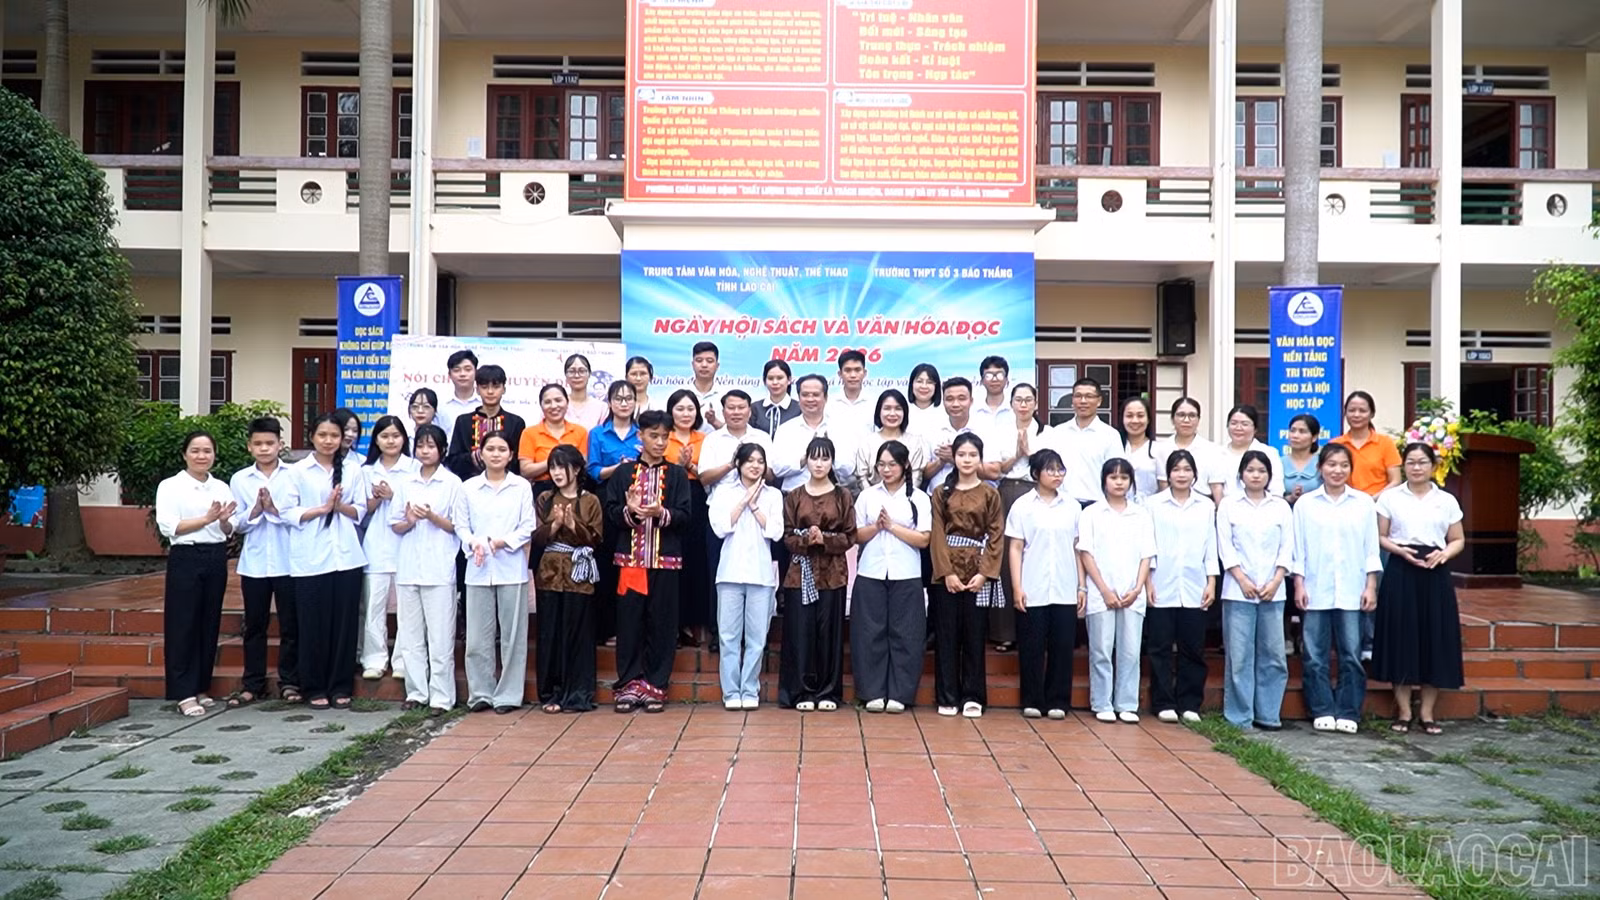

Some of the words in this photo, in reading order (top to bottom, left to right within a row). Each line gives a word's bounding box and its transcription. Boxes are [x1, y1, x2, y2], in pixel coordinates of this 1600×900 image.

[878, 12, 896, 24] tuệ
[908, 12, 938, 22] Nhân
[942, 13, 963, 23] văn
[859, 24, 878, 37] Đổi
[882, 26, 904, 37] mới
[916, 26, 946, 38] Sáng
[949, 28, 967, 38] tạo
[860, 41, 892, 52] Trung
[896, 41, 921, 53] thực
[932, 41, 966, 52] Trách
[968, 42, 1005, 54] nhiệm
[859, 54, 888, 65] Đoàn
[892, 54, 911, 65] kết
[938, 55, 960, 66] luật
[859, 69, 880, 79] Tôn
[883, 69, 914, 80] trọng
[926, 70, 948, 80] Hợp
[643, 266, 673, 277] TRUNG
[676, 266, 695, 276] TÂM
[698, 266, 716, 276] VĂN
[719, 266, 740, 278] HÓA,
[805, 264, 822, 277] THỂ
[825, 267, 848, 277] THAO
[874, 267, 910, 278] TRƯỜNG
[913, 268, 936, 278] THPT
[938, 266, 950, 278] SỐ
[953, 268, 959, 278] 3
[962, 266, 980, 278] BẢO
[983, 266, 1012, 278] THẮNG
[716, 280, 737, 292] TỈNH
[760, 282, 776, 292] CAI
[654, 314, 716, 334] NGÀY
[719, 315, 758, 338] HỘI
[763, 315, 817, 334] SÁCH
[824, 316, 849, 334] VÀ
[856, 316, 898, 334] VĂN
[905, 316, 949, 335] HÓA
[956, 320, 1000, 340] ĐỌC
[1276, 336, 1295, 347] VĂN
[1296, 336, 1314, 347] HÓA
[1317, 337, 1335, 348] ĐỌC
[772, 343, 818, 362] NĂM
[1283, 350, 1302, 362] NỀN
[1304, 350, 1327, 362] TẢNG
[377, 370, 390, 379] LUYỆ
[404, 371, 427, 383] NÓI
[1286, 368, 1300, 378] TRI
[1302, 366, 1325, 378] THỨC
[666, 376, 684, 385] hóa
[714, 374, 735, 385] Nền
[737, 376, 760, 388] tảng
[876, 376, 893, 388] tập
[896, 376, 908, 386] và
[1280, 384, 1299, 393] CHO
[1301, 382, 1313, 393] XÃ
[1315, 383, 1330, 394] HỘI
[1286, 399, 1305, 410] HỌC
[1306, 398, 1324, 409] TẬP
